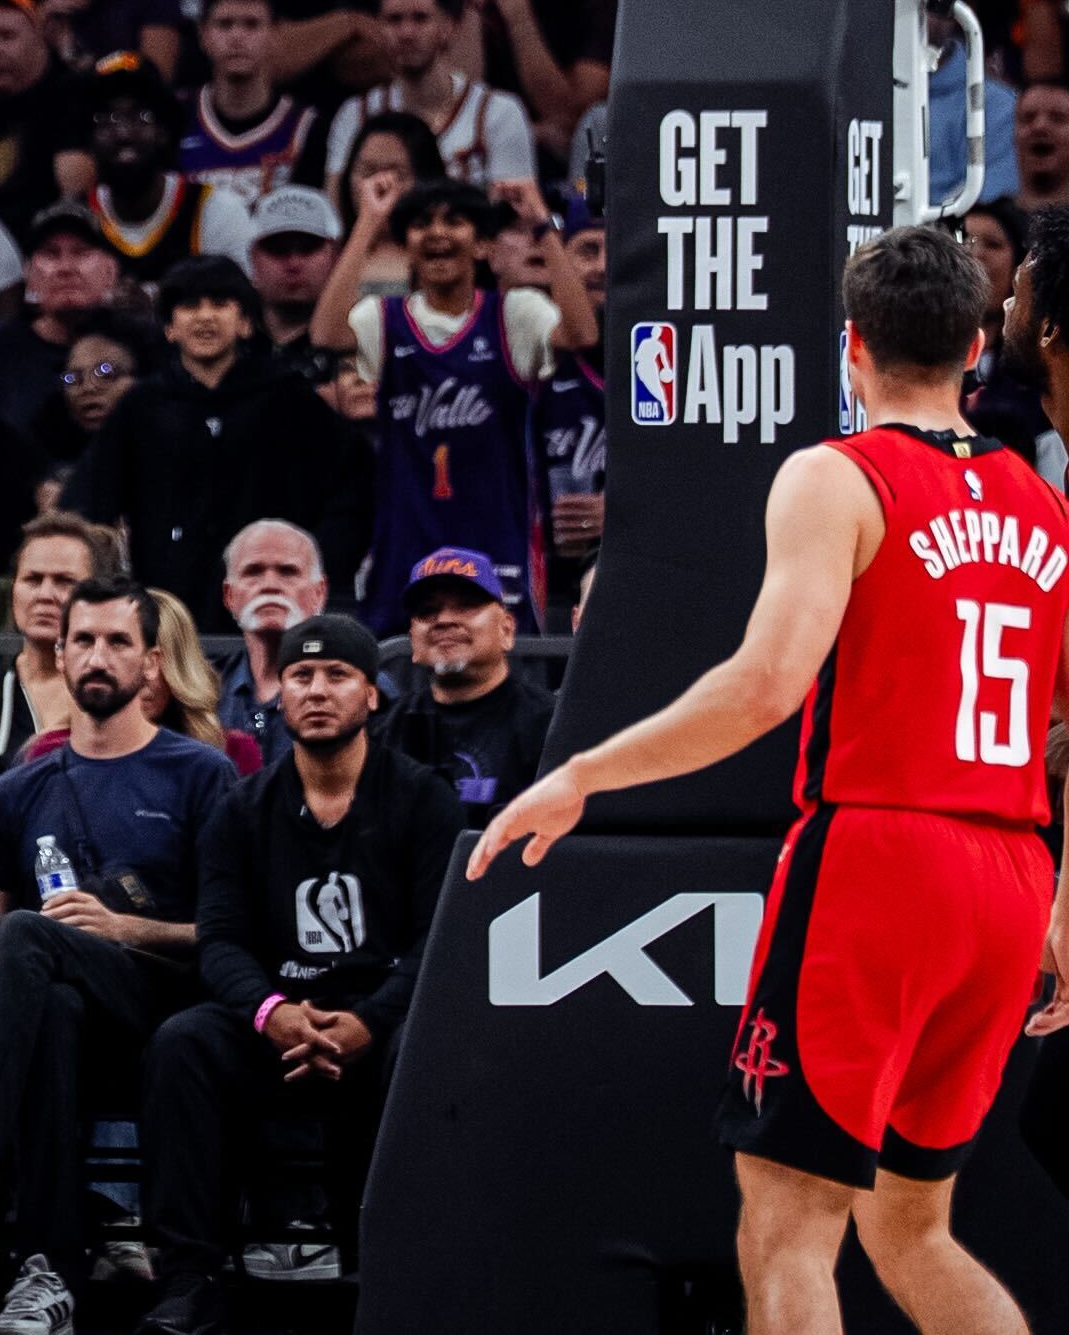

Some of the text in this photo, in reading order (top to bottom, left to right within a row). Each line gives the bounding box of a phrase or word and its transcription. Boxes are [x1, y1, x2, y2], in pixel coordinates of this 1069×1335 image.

[658, 109, 769, 208] GET
[847, 117, 884, 217] GET
[657, 215, 769, 312] THE
[638, 400, 660, 419] NBA
[683, 323, 796, 444] App
[432, 441, 454, 501] 1
[908, 508, 1069, 593] SHEPPARD
[955, 598, 1033, 769] 15
